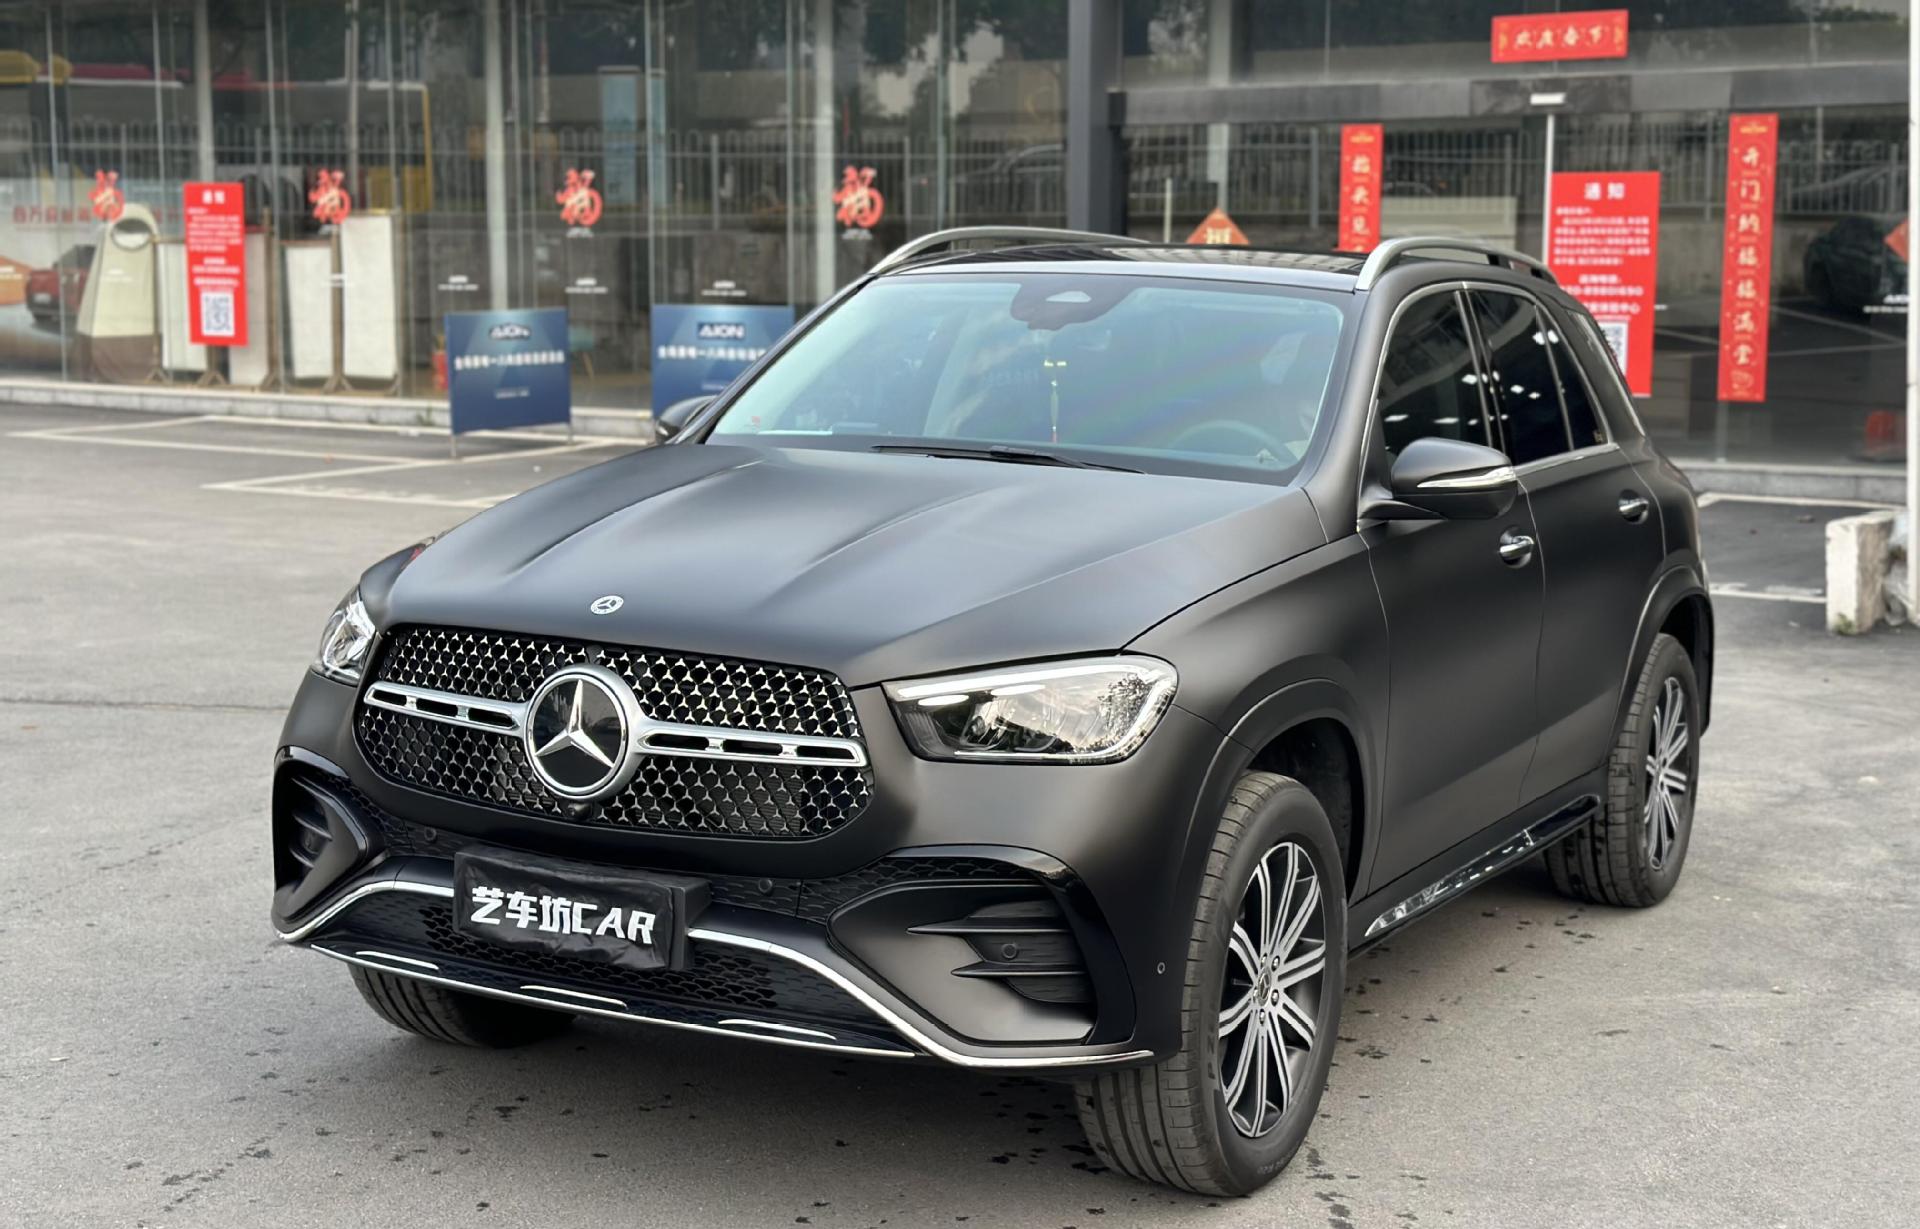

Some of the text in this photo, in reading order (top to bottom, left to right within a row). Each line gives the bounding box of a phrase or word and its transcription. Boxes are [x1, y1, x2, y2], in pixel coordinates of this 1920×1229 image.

[1513, 24, 1603, 49] 欢度春节
[1350, 154, 1371, 252] 抬头见
[699, 324, 744, 338] AION
